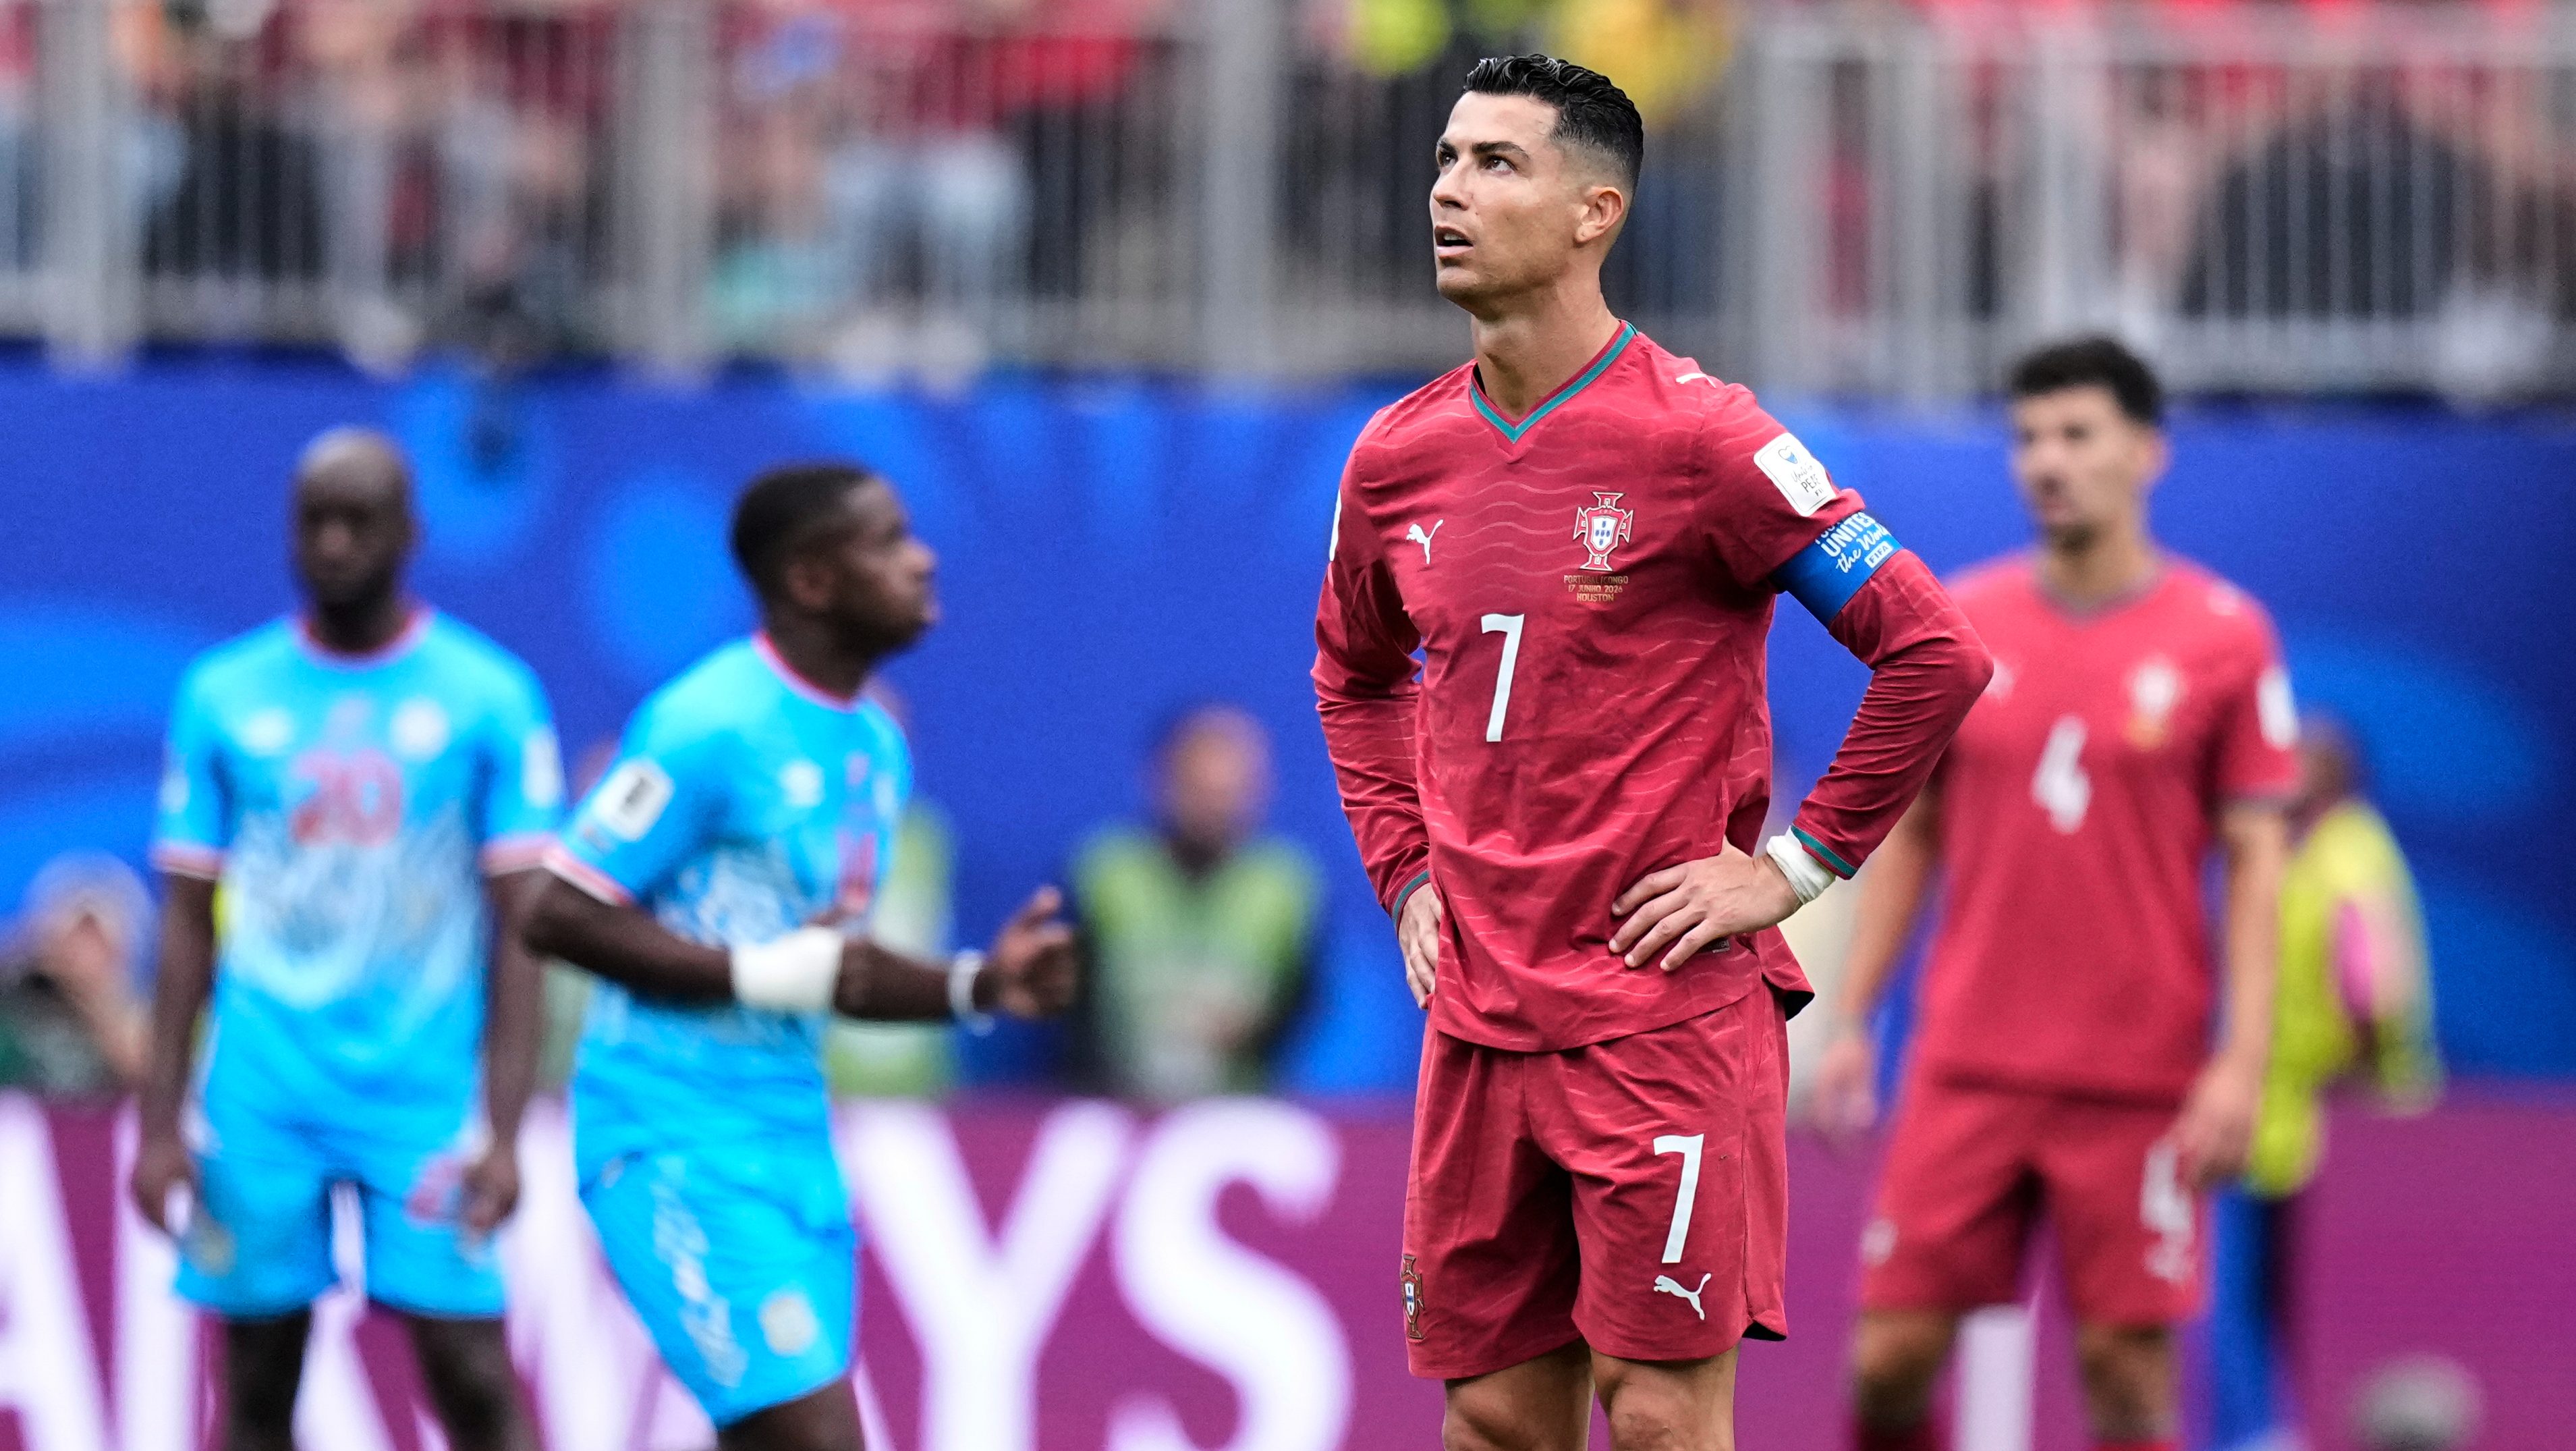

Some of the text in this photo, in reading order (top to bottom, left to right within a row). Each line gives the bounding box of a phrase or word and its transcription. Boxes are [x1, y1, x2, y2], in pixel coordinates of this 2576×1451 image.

[1820, 512, 1876, 557] UNITES
[1868, 545, 1889, 564] FIFA
[1835, 553, 1861, 573] the
[1568, 584, 1623, 593] 17 JUNHO 2026
[1576, 593, 1615, 602] HOUSTON
[1480, 613, 1525, 742] 7
[2032, 714, 2092, 836] 4
[290, 748, 403, 848] 20
[1652, 1133, 1704, 1264] 7
